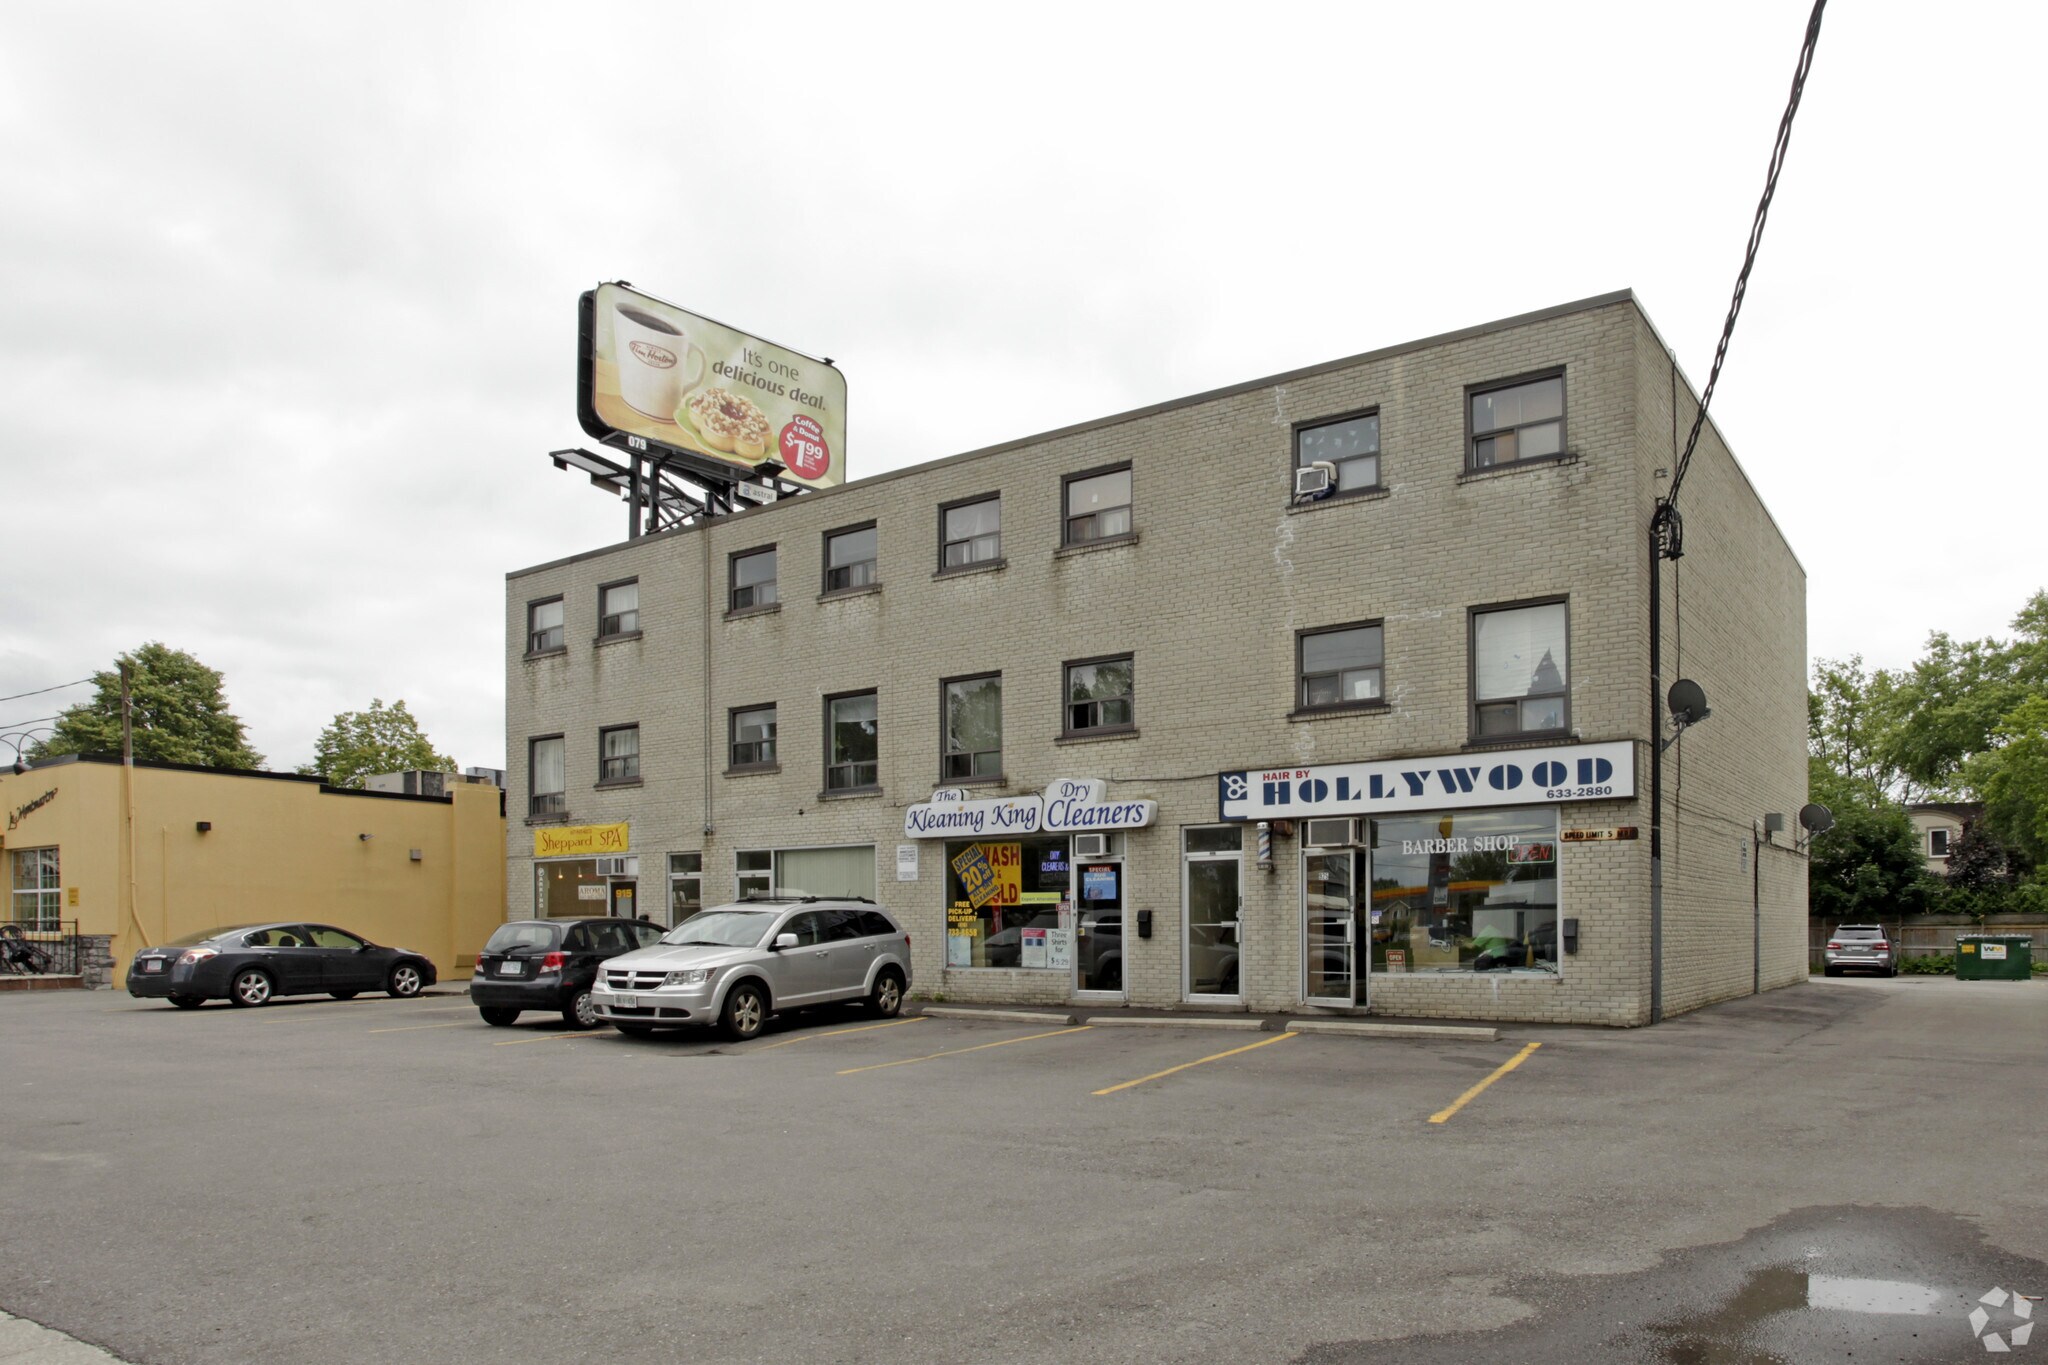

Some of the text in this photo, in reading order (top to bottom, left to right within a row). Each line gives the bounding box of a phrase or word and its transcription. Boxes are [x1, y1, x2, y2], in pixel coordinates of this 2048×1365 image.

[743, 348, 799, 381] It's one
[712, 361, 826, 411] delicious deal.
[795, 416, 820, 434] Coffee
[628, 435, 647, 450] 079
[752, 488, 773, 500] astral
[1263, 770, 1310, 781] HAIR BY
[1263, 757, 1613, 806] HOLLYWOOD
[936, 790, 957, 801] The
[1060, 782, 1091, 802] Dry
[1546, 786, 1612, 799] 633-2880
[907, 803, 1037, 833] Kleaning King
[1047, 798, 1145, 828] Cleaners
[541, 828, 622, 852] Sheppard SPA
[1564, 831, 1584, 839] SPEED
[1607, 830, 1613, 838] 5
[1402, 835, 1520, 855] BARBER SHOP
[1509, 843, 1551, 862] OPEN
[953, 845, 982, 871] SPECIAL
[580, 887, 605, 895] AROMA
[615, 889, 633, 898] 915
[974, 885, 1000, 905] CLEANING
